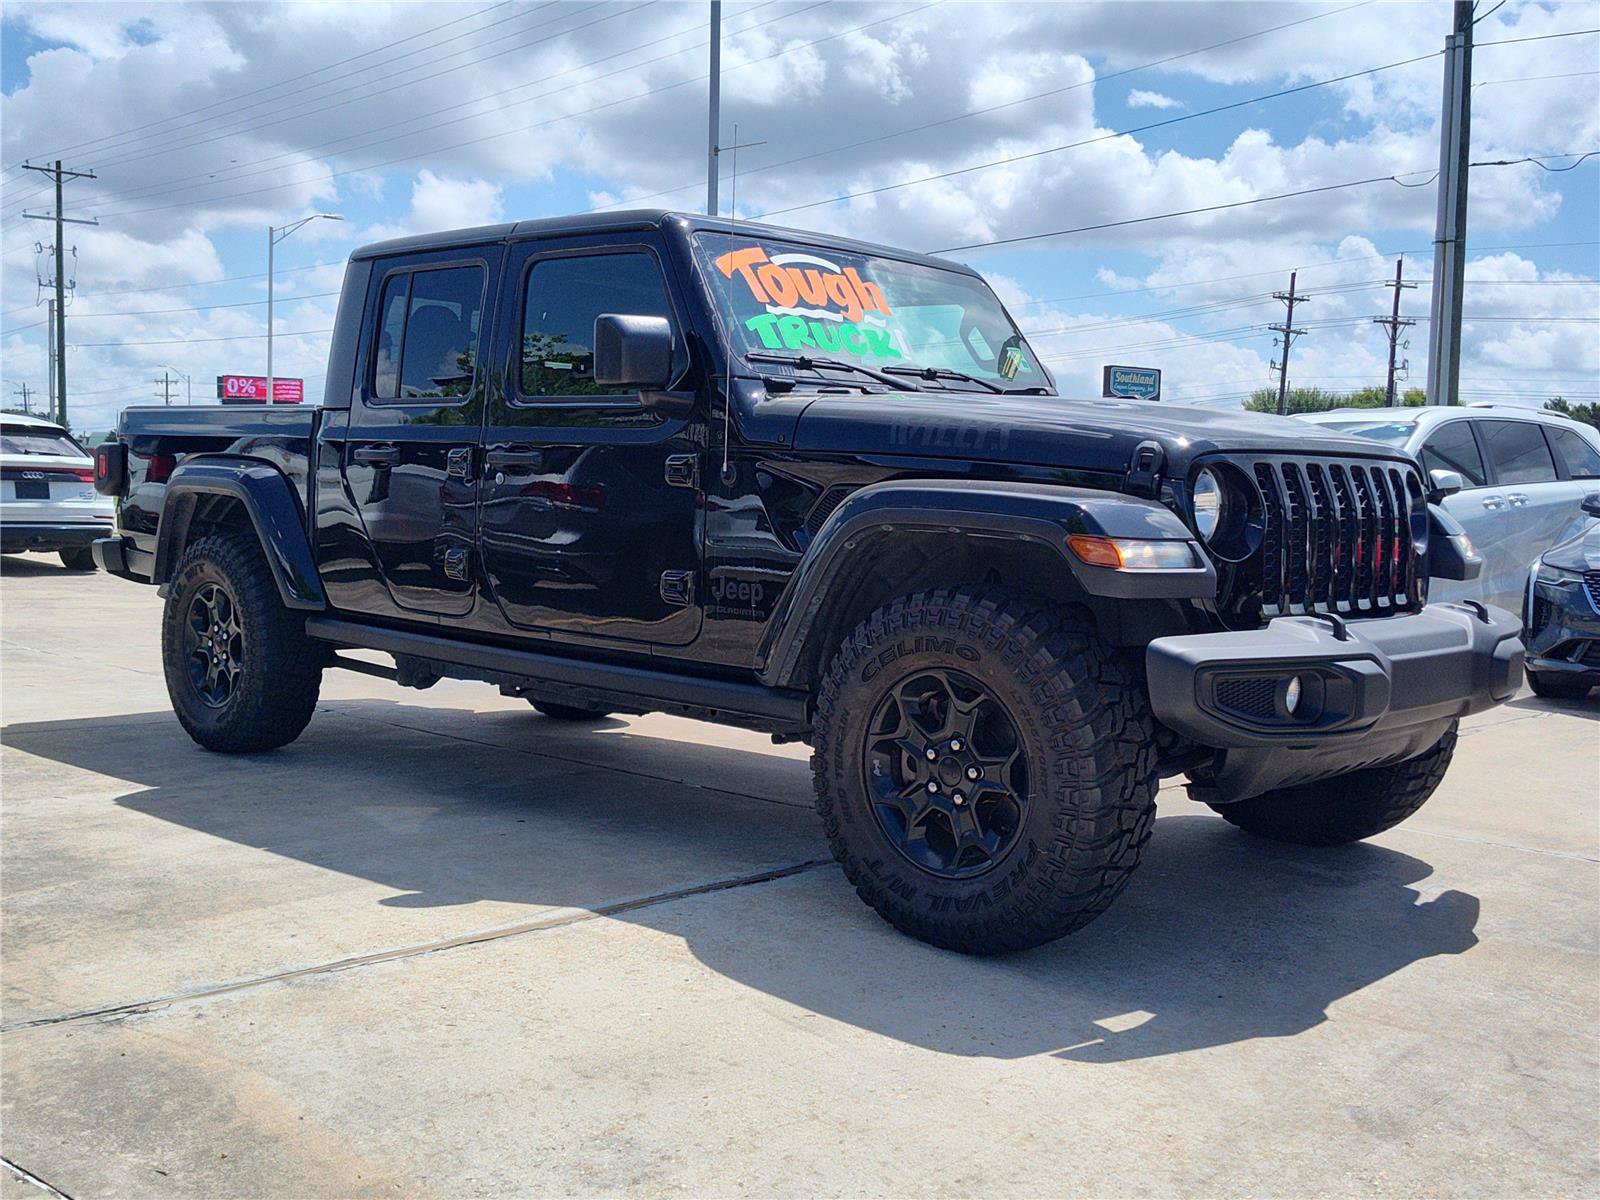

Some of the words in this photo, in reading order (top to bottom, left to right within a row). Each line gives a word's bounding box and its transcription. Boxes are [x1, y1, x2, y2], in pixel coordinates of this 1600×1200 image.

[715, 247, 893, 323] Tough
[745, 313, 902, 358] TRUCK
[227, 378, 256, 394] 0%
[1115, 371, 1155, 385] Southland
[711, 576, 764, 607] Jeep
[861, 635, 980, 682] CELIMO
[924, 838, 1039, 912] PREVAIL
